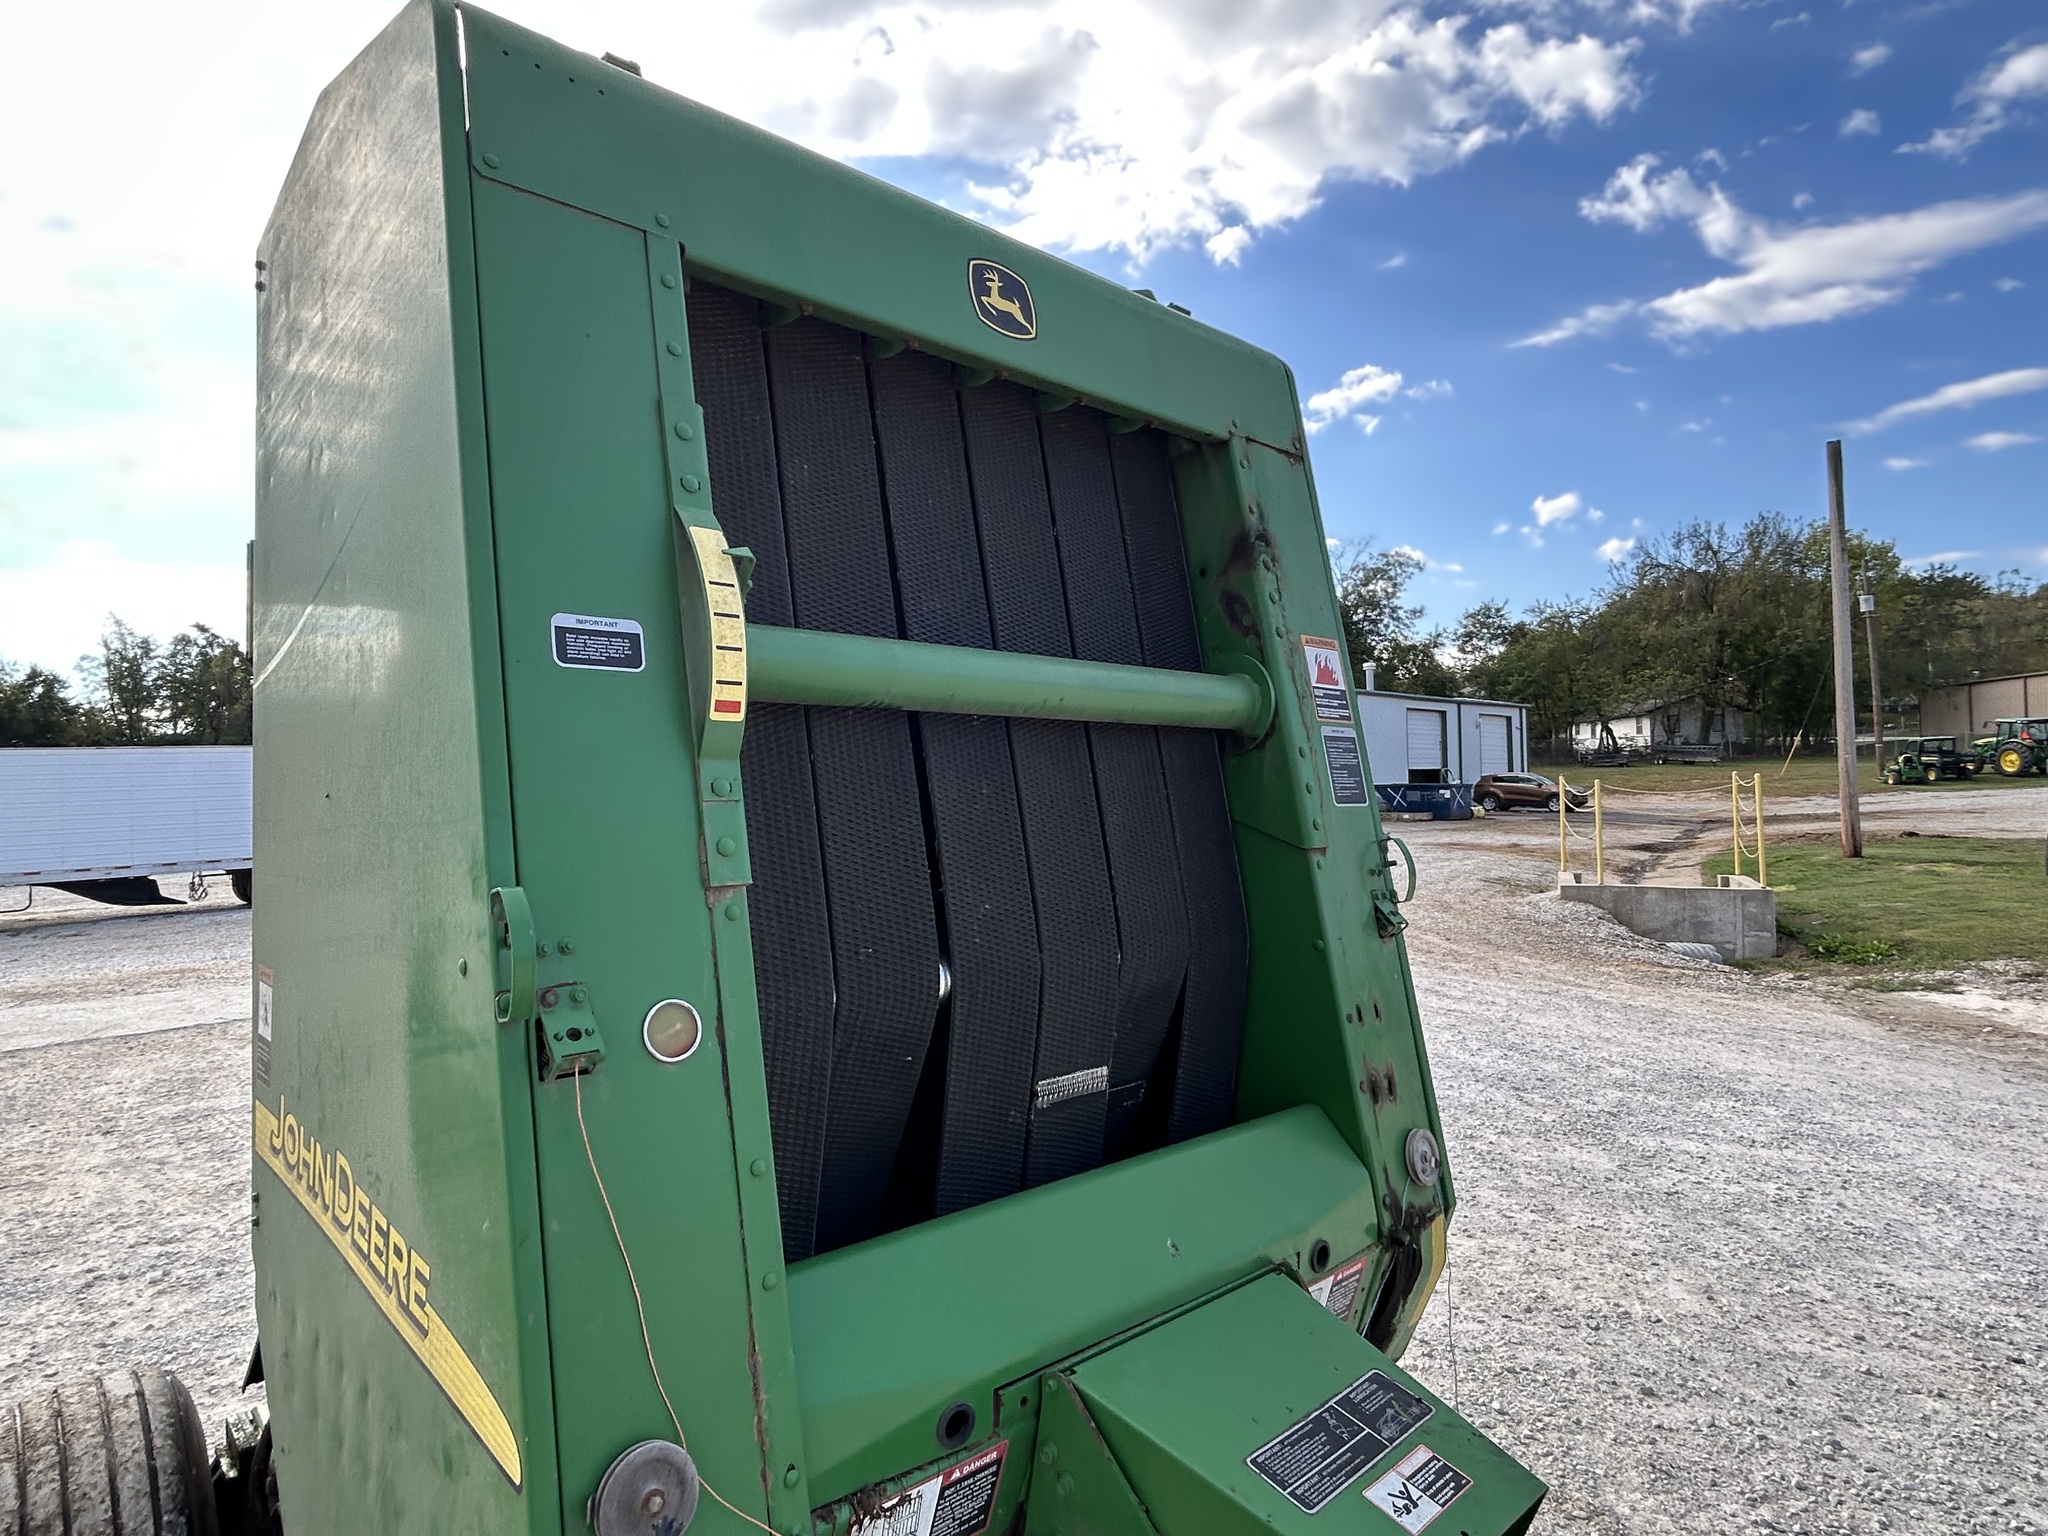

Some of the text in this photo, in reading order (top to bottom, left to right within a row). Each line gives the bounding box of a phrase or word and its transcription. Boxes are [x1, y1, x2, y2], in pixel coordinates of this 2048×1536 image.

[575, 618, 618, 628] IMPORTANT
[335, 1150, 431, 1333] DEERE
[963, 1451, 997, 1474] DANGER
